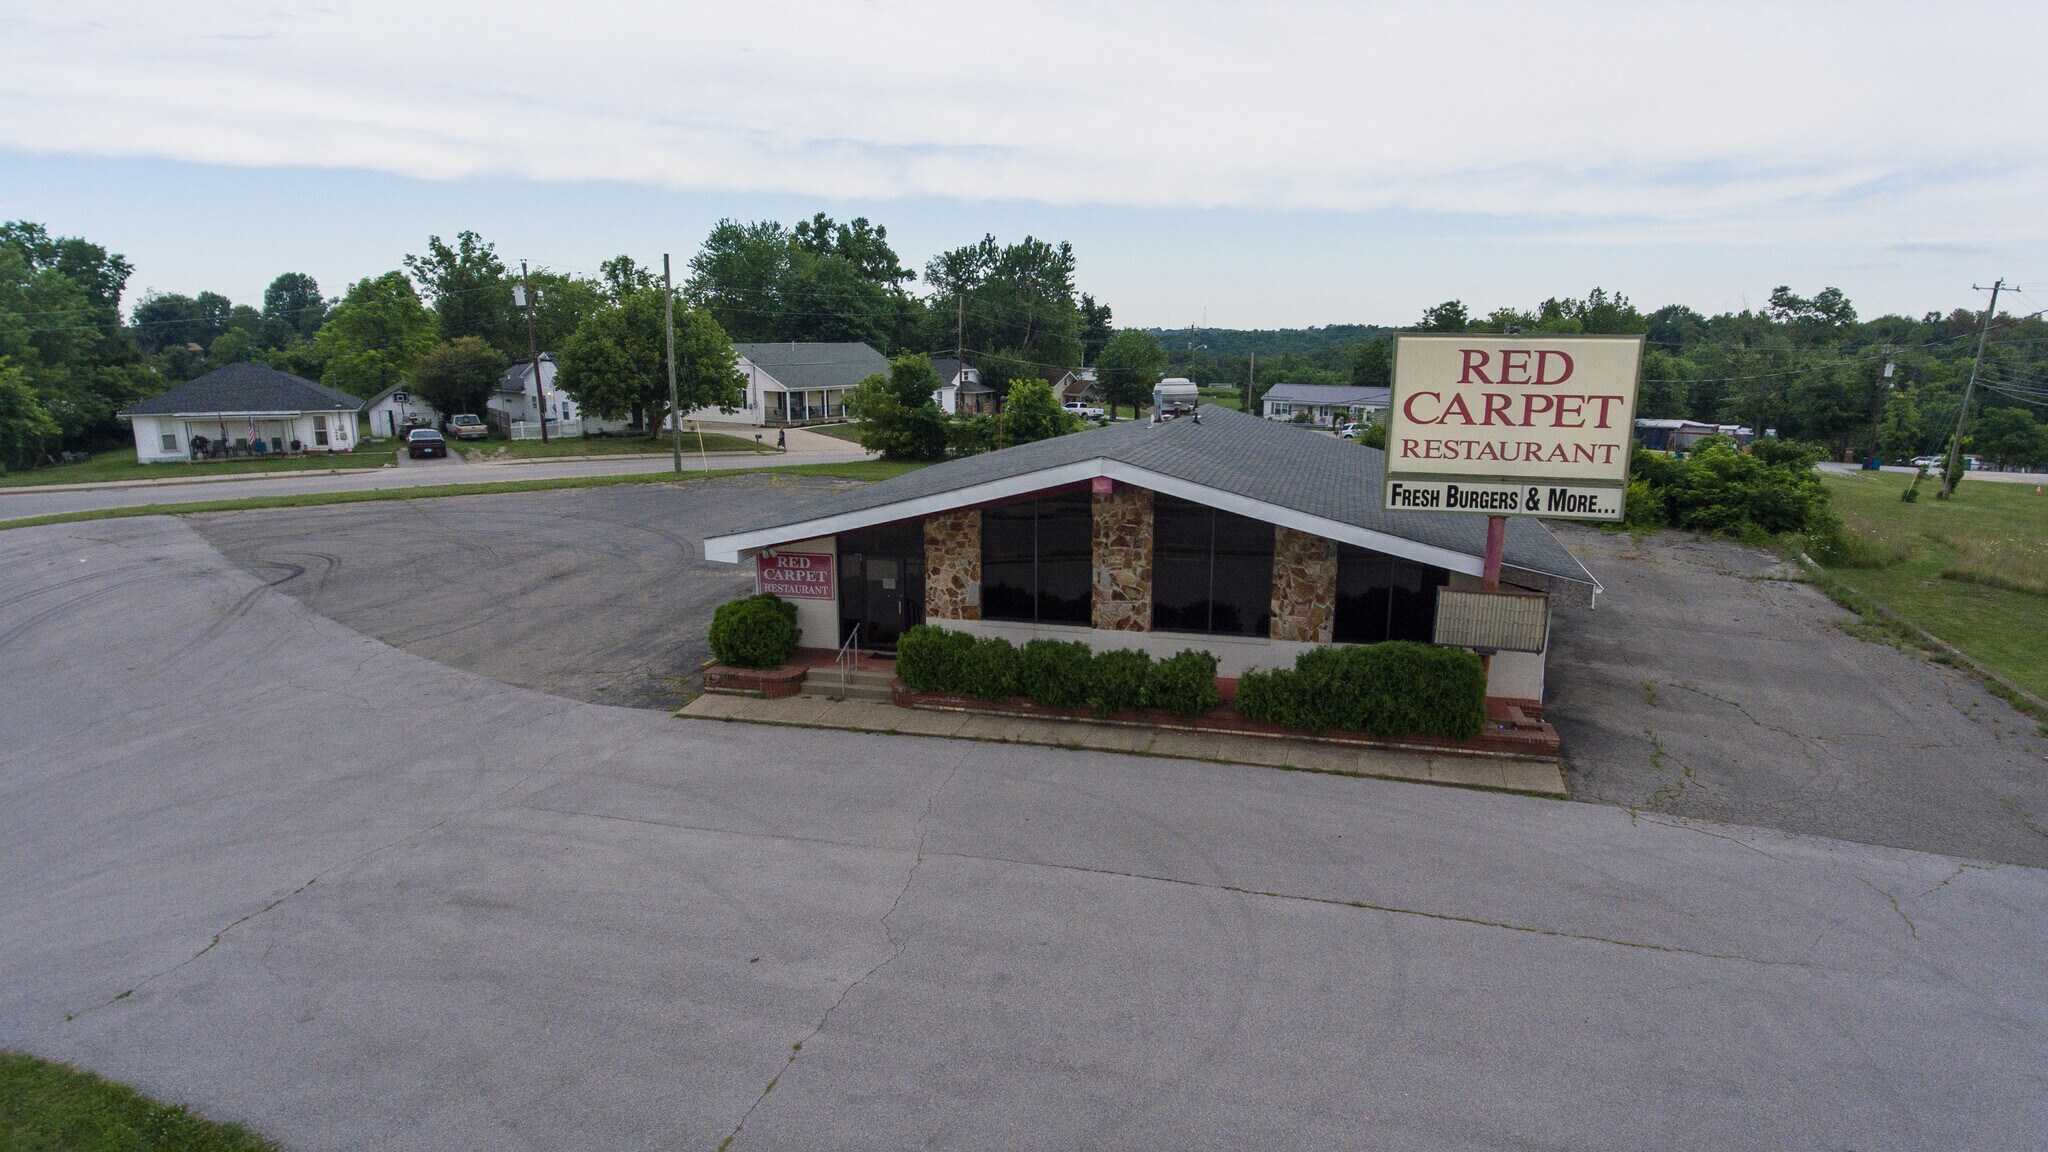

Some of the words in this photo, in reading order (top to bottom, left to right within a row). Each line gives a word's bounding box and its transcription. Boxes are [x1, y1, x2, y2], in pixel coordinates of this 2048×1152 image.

[1456, 349, 1575, 385] RED
[1403, 391, 1624, 429] CARPET
[1400, 438, 1620, 464] RESTAURANT
[1391, 483, 1440, 508] FRESH
[1446, 485, 1519, 511] BURGERS
[1525, 487, 1540, 512] &
[1547, 488, 1616, 515] MORE...
[777, 556, 811, 568] RED
[763, 568, 827, 583] CARPET
[764, 583, 829, 595] RESTAURANT
